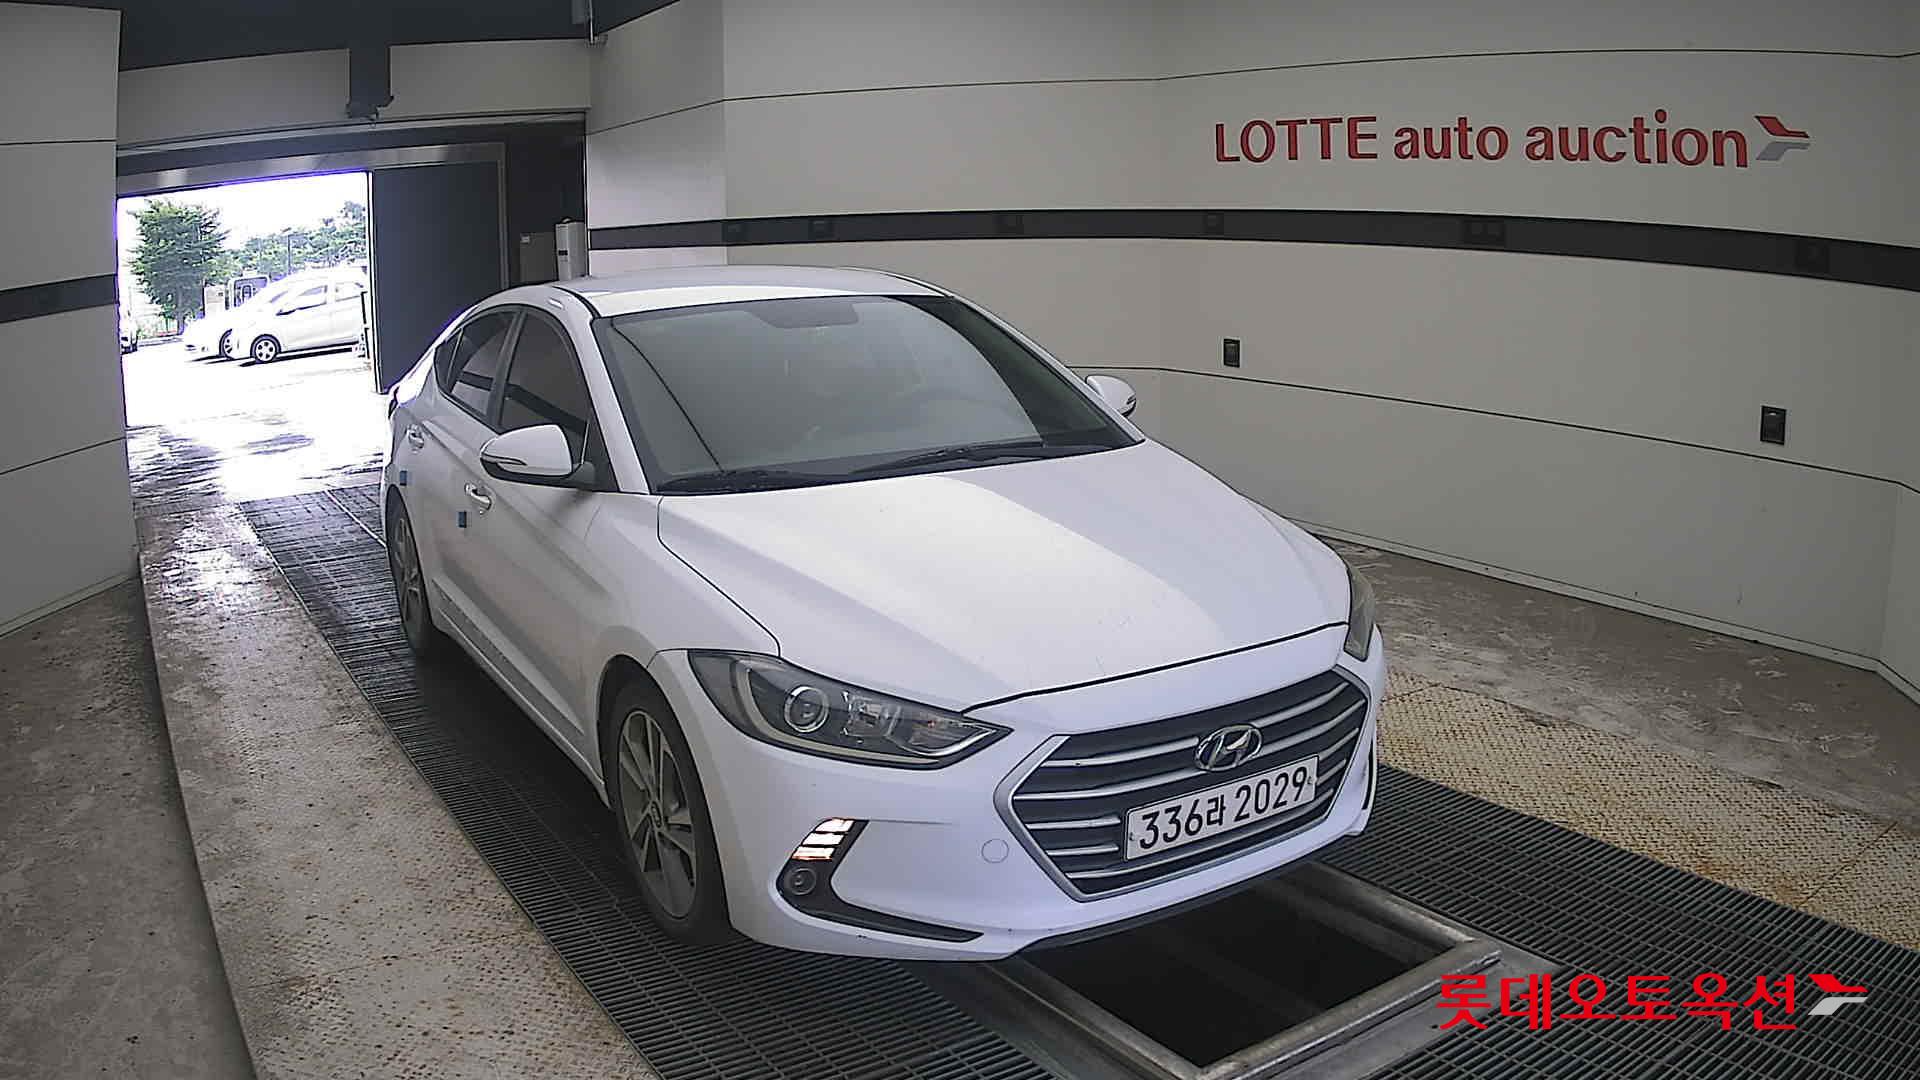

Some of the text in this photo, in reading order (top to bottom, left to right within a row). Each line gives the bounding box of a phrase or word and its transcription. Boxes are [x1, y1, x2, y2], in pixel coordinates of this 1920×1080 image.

[1215, 109, 1749, 168] LOTTE auto auction
[1139, 766, 1308, 850] 336라 2029
